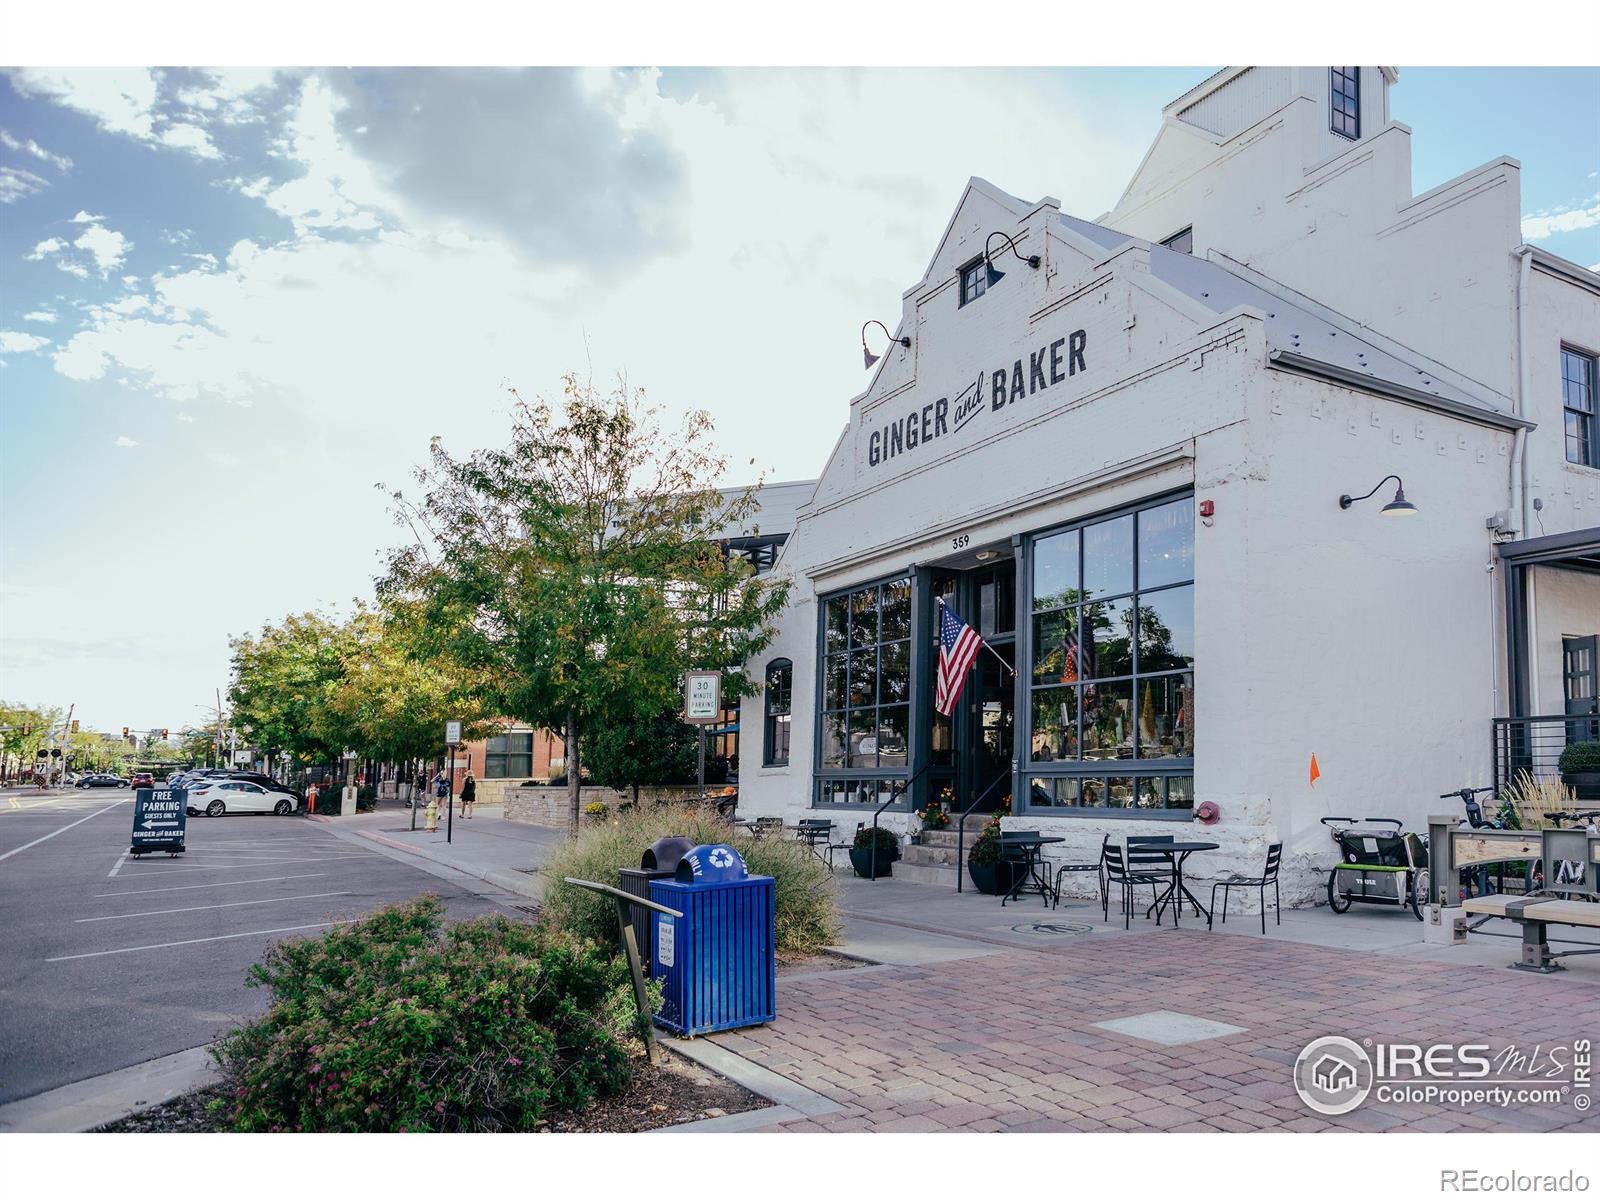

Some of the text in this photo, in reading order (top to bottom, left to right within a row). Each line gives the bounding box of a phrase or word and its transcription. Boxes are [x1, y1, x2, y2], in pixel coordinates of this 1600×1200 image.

[868, 328, 1088, 468] GINGER and BAKER
[952, 534, 970, 550] 359
[697, 681, 709, 690] 30
[152, 791, 172, 800] FREE
[142, 801, 180, 811] PARKING
[690, 855, 703, 876] ONLY
